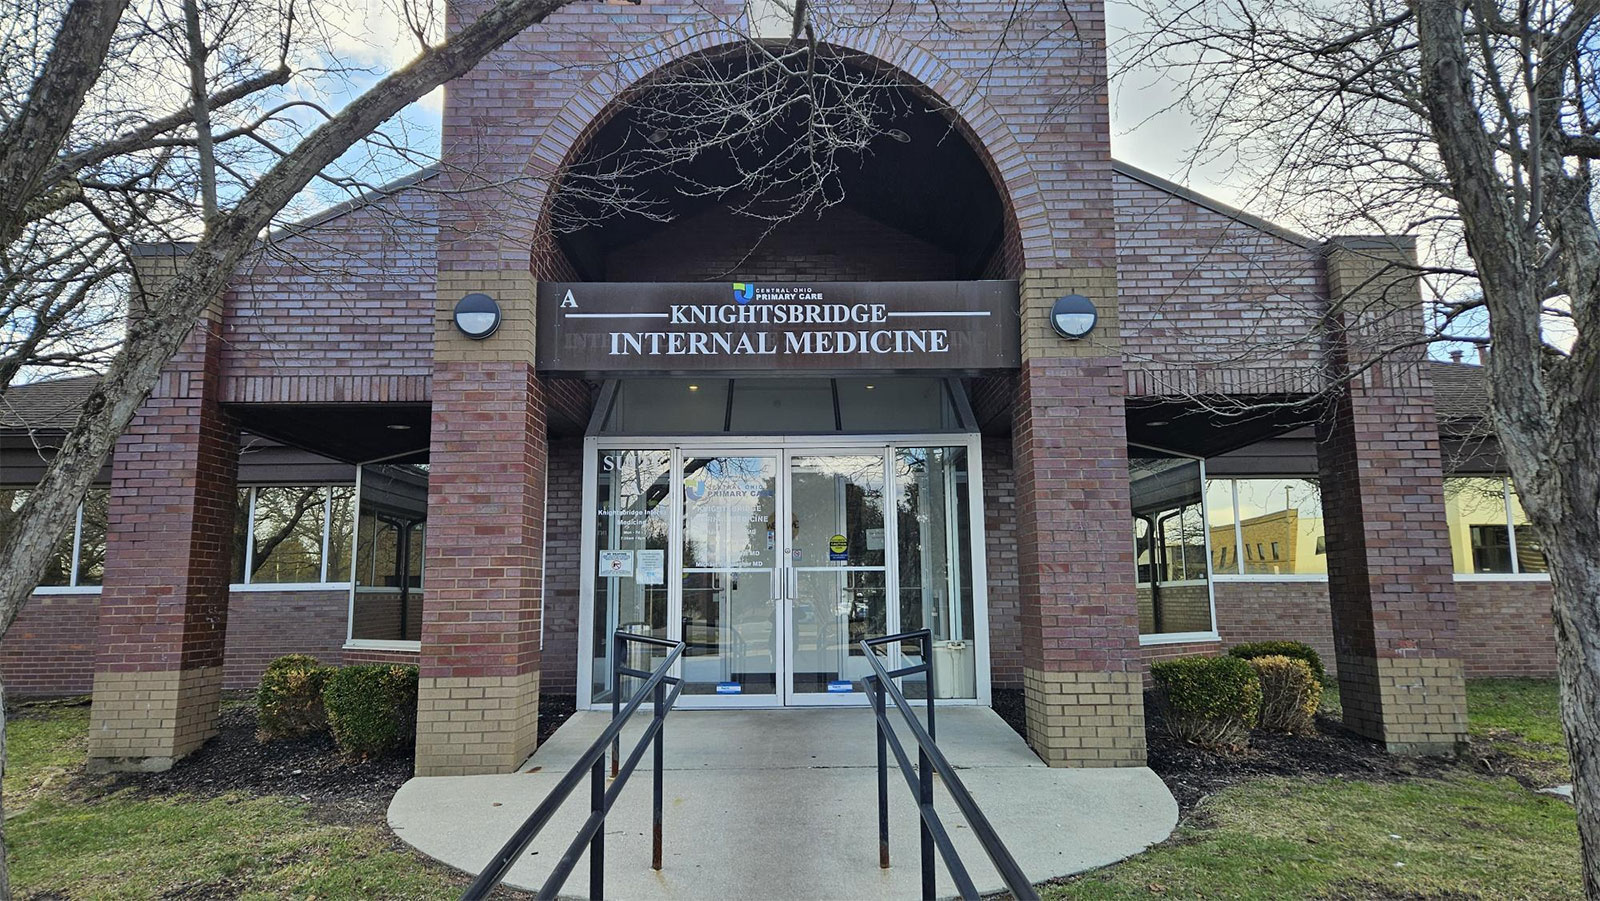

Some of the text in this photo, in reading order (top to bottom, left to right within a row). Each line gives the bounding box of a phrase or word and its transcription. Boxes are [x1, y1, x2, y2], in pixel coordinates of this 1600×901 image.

[560, 288, 579, 308] A
[755, 292, 823, 301] PRIMARY CARE
[669, 303, 887, 324] KNIGHTSBRIDGE
[608, 331, 777, 356] INTERNAL
[783, 329, 950, 355] MEDICINE
